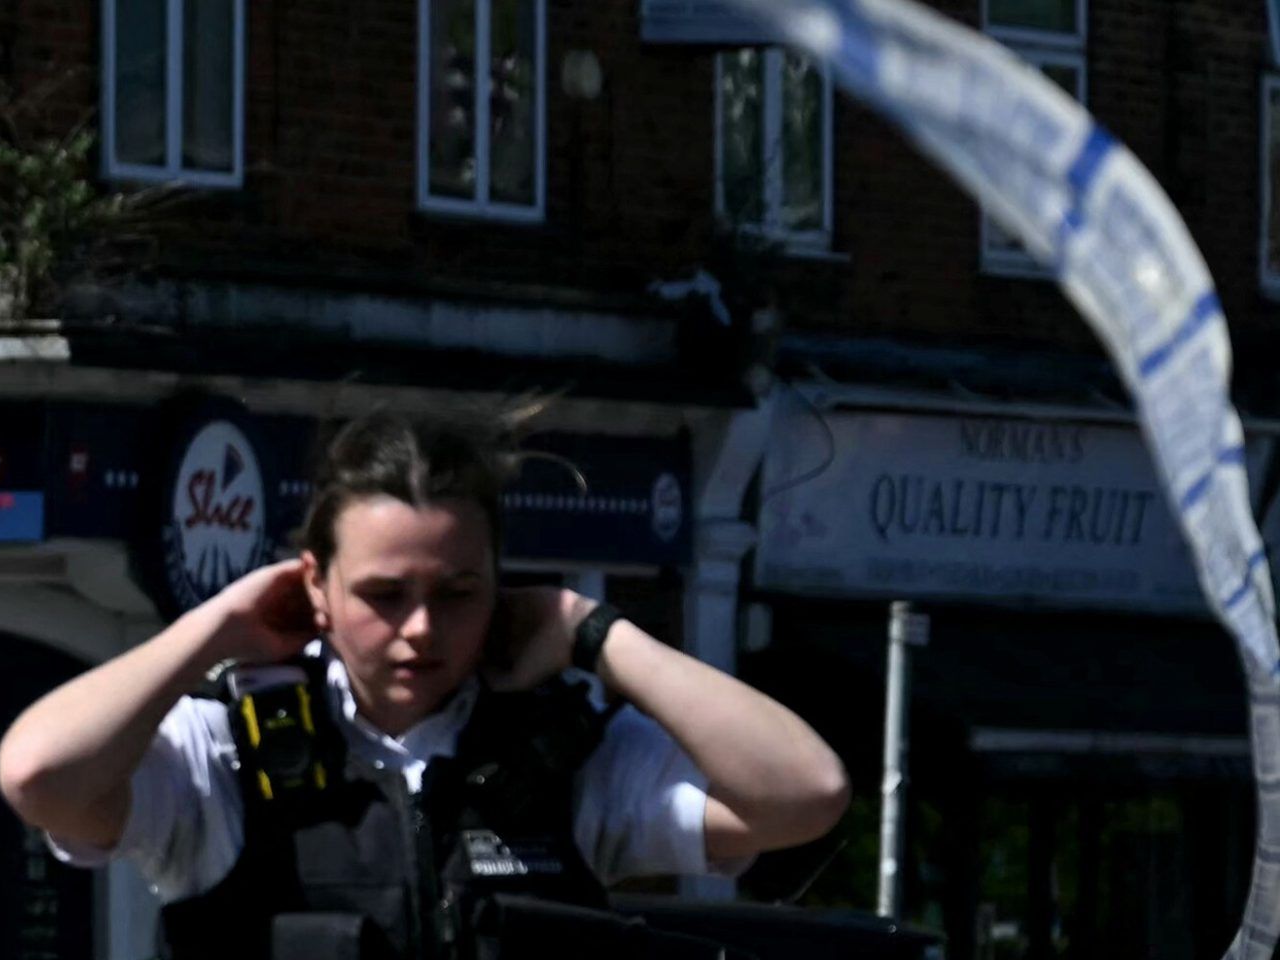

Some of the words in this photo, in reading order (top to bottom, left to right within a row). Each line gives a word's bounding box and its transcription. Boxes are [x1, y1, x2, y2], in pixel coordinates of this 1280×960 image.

[185, 469, 255, 532] Slice
[871, 474, 1037, 544] QUALITY
[1045, 485, 1158, 546] FRUIT
